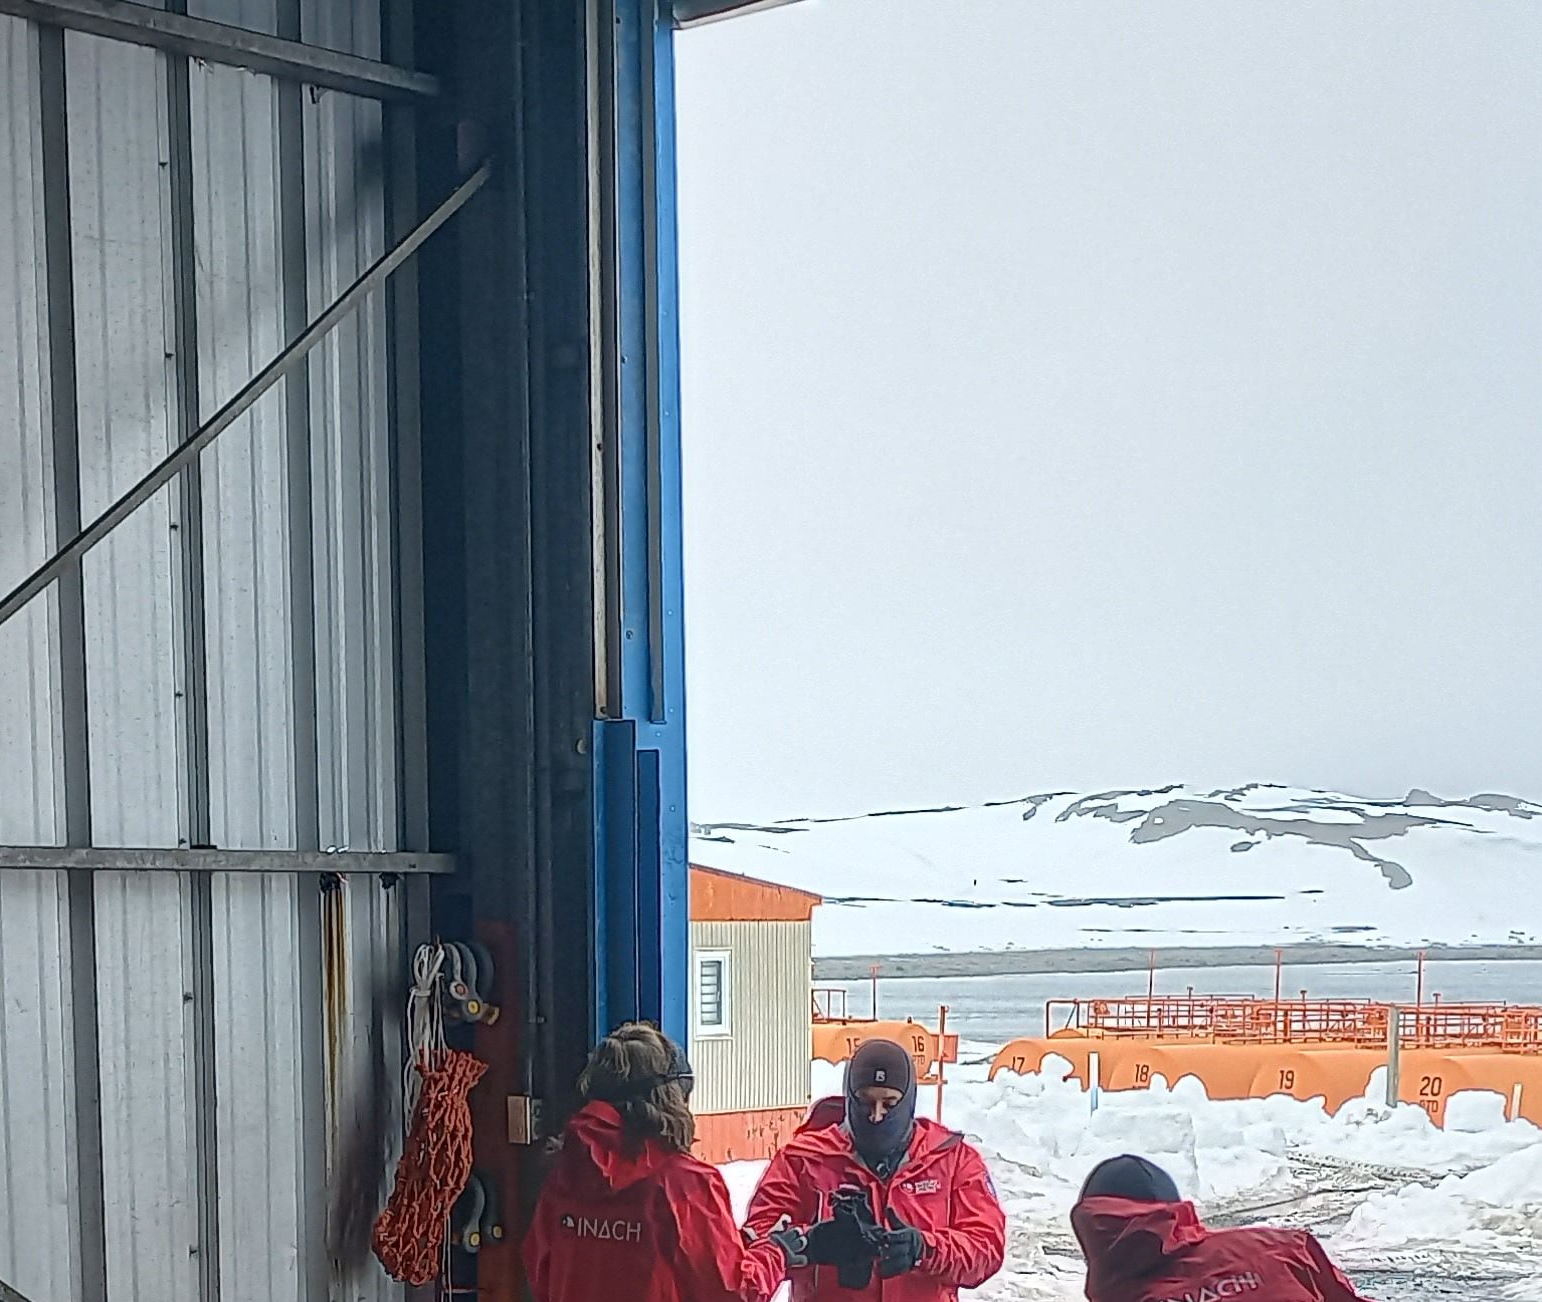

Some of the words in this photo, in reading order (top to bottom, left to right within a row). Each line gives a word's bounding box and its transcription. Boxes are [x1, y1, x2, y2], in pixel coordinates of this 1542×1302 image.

[911, 1035, 925, 1053] 16
[1012, 1056, 1025, 1073] 17
[1134, 1064, 1150, 1083] 18
[1278, 1069, 1295, 1090] 19
[1419, 1075, 1443, 1097] 20
[577, 1217, 641, 1242] INACH
